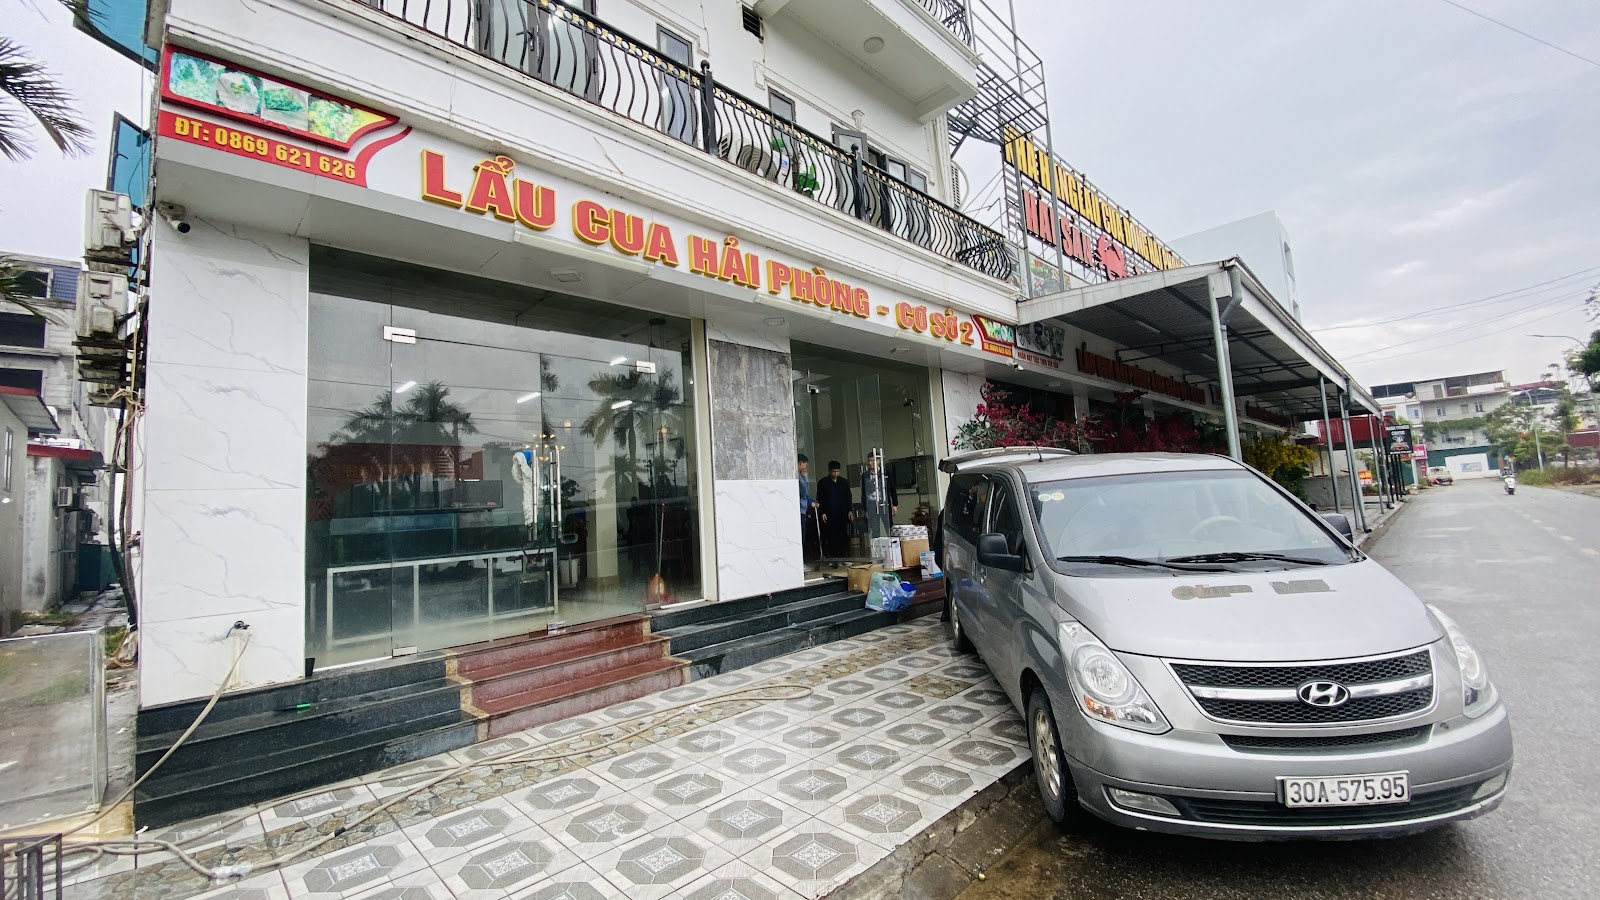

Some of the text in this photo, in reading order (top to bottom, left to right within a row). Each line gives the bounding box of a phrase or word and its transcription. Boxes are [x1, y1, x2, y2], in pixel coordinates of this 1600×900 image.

[174, 117, 356, 179] ĐT: 0869 621 626
[421, 148, 557, 231] LẨU
[572, 200, 679, 268] CUA
[687, 234, 760, 289] HẢI
[766, 259, 870, 318] PHÒNG
[896, 302, 928, 333] CƠ
[930, 308, 959, 342] SỞ
[959, 321, 975, 346] 2
[1290, 776, 1405, 804] 30A-575.95
